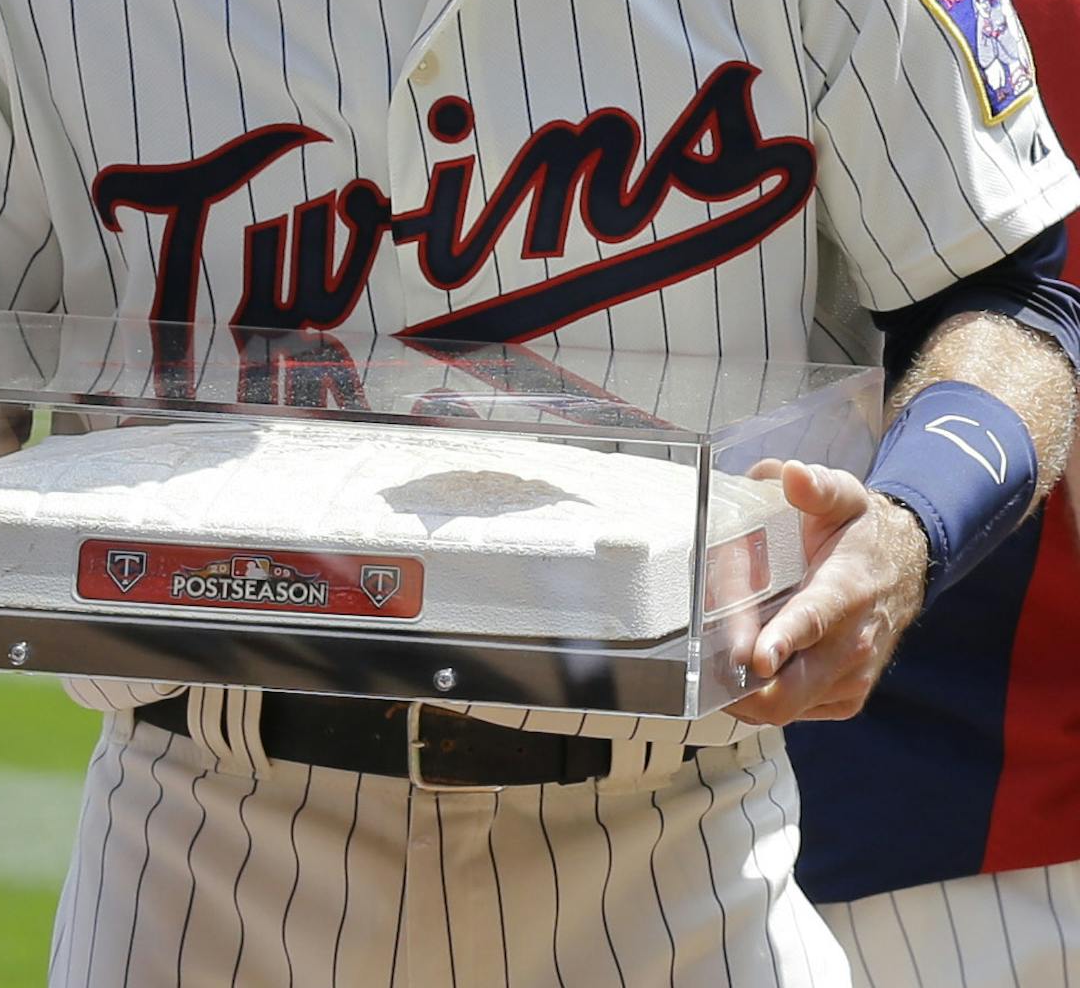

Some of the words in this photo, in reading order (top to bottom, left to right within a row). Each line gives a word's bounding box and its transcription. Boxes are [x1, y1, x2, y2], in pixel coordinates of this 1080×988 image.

[92, 60, 817, 342] Twins
[209, 563, 228, 574] 20
[172, 574, 327, 606] POSTSEASON
